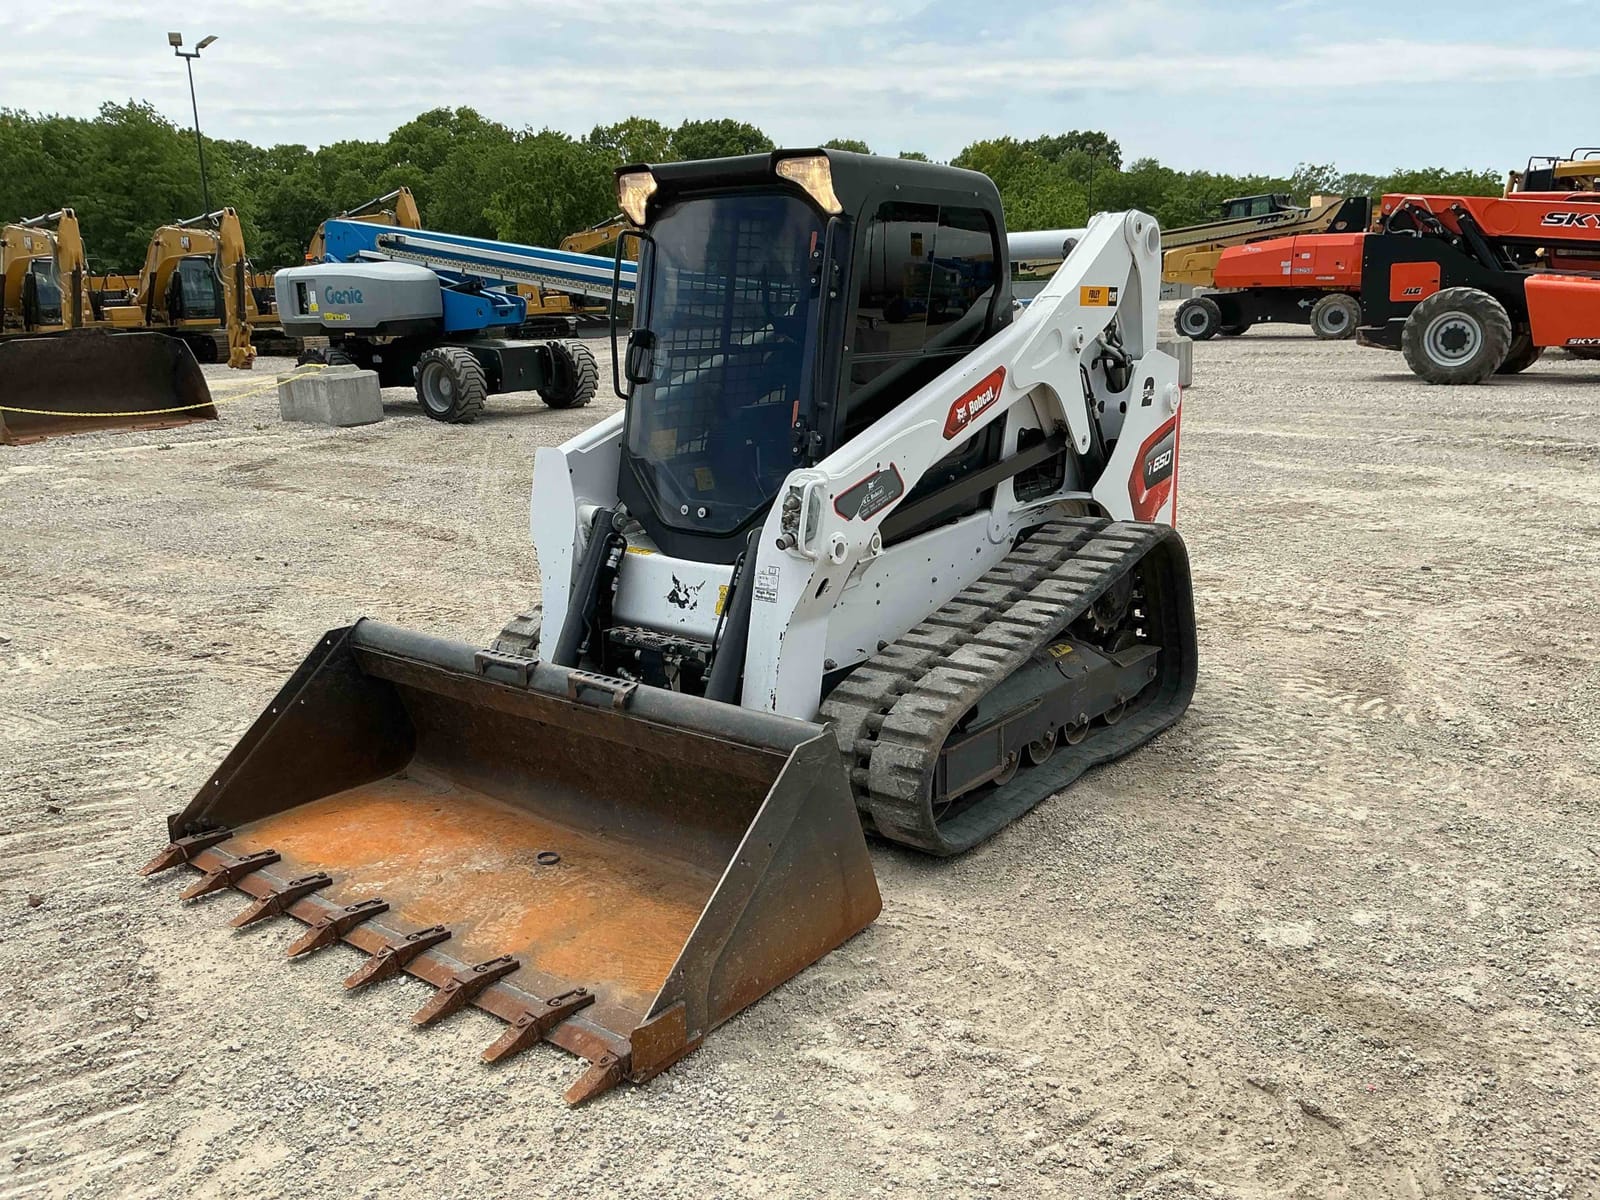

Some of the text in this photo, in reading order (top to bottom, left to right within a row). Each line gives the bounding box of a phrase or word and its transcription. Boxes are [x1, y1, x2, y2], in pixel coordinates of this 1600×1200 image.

[325, 285, 364, 305] Genie
[1402, 287, 1423, 296] JLG
[968, 385, 994, 416] Bobcat
